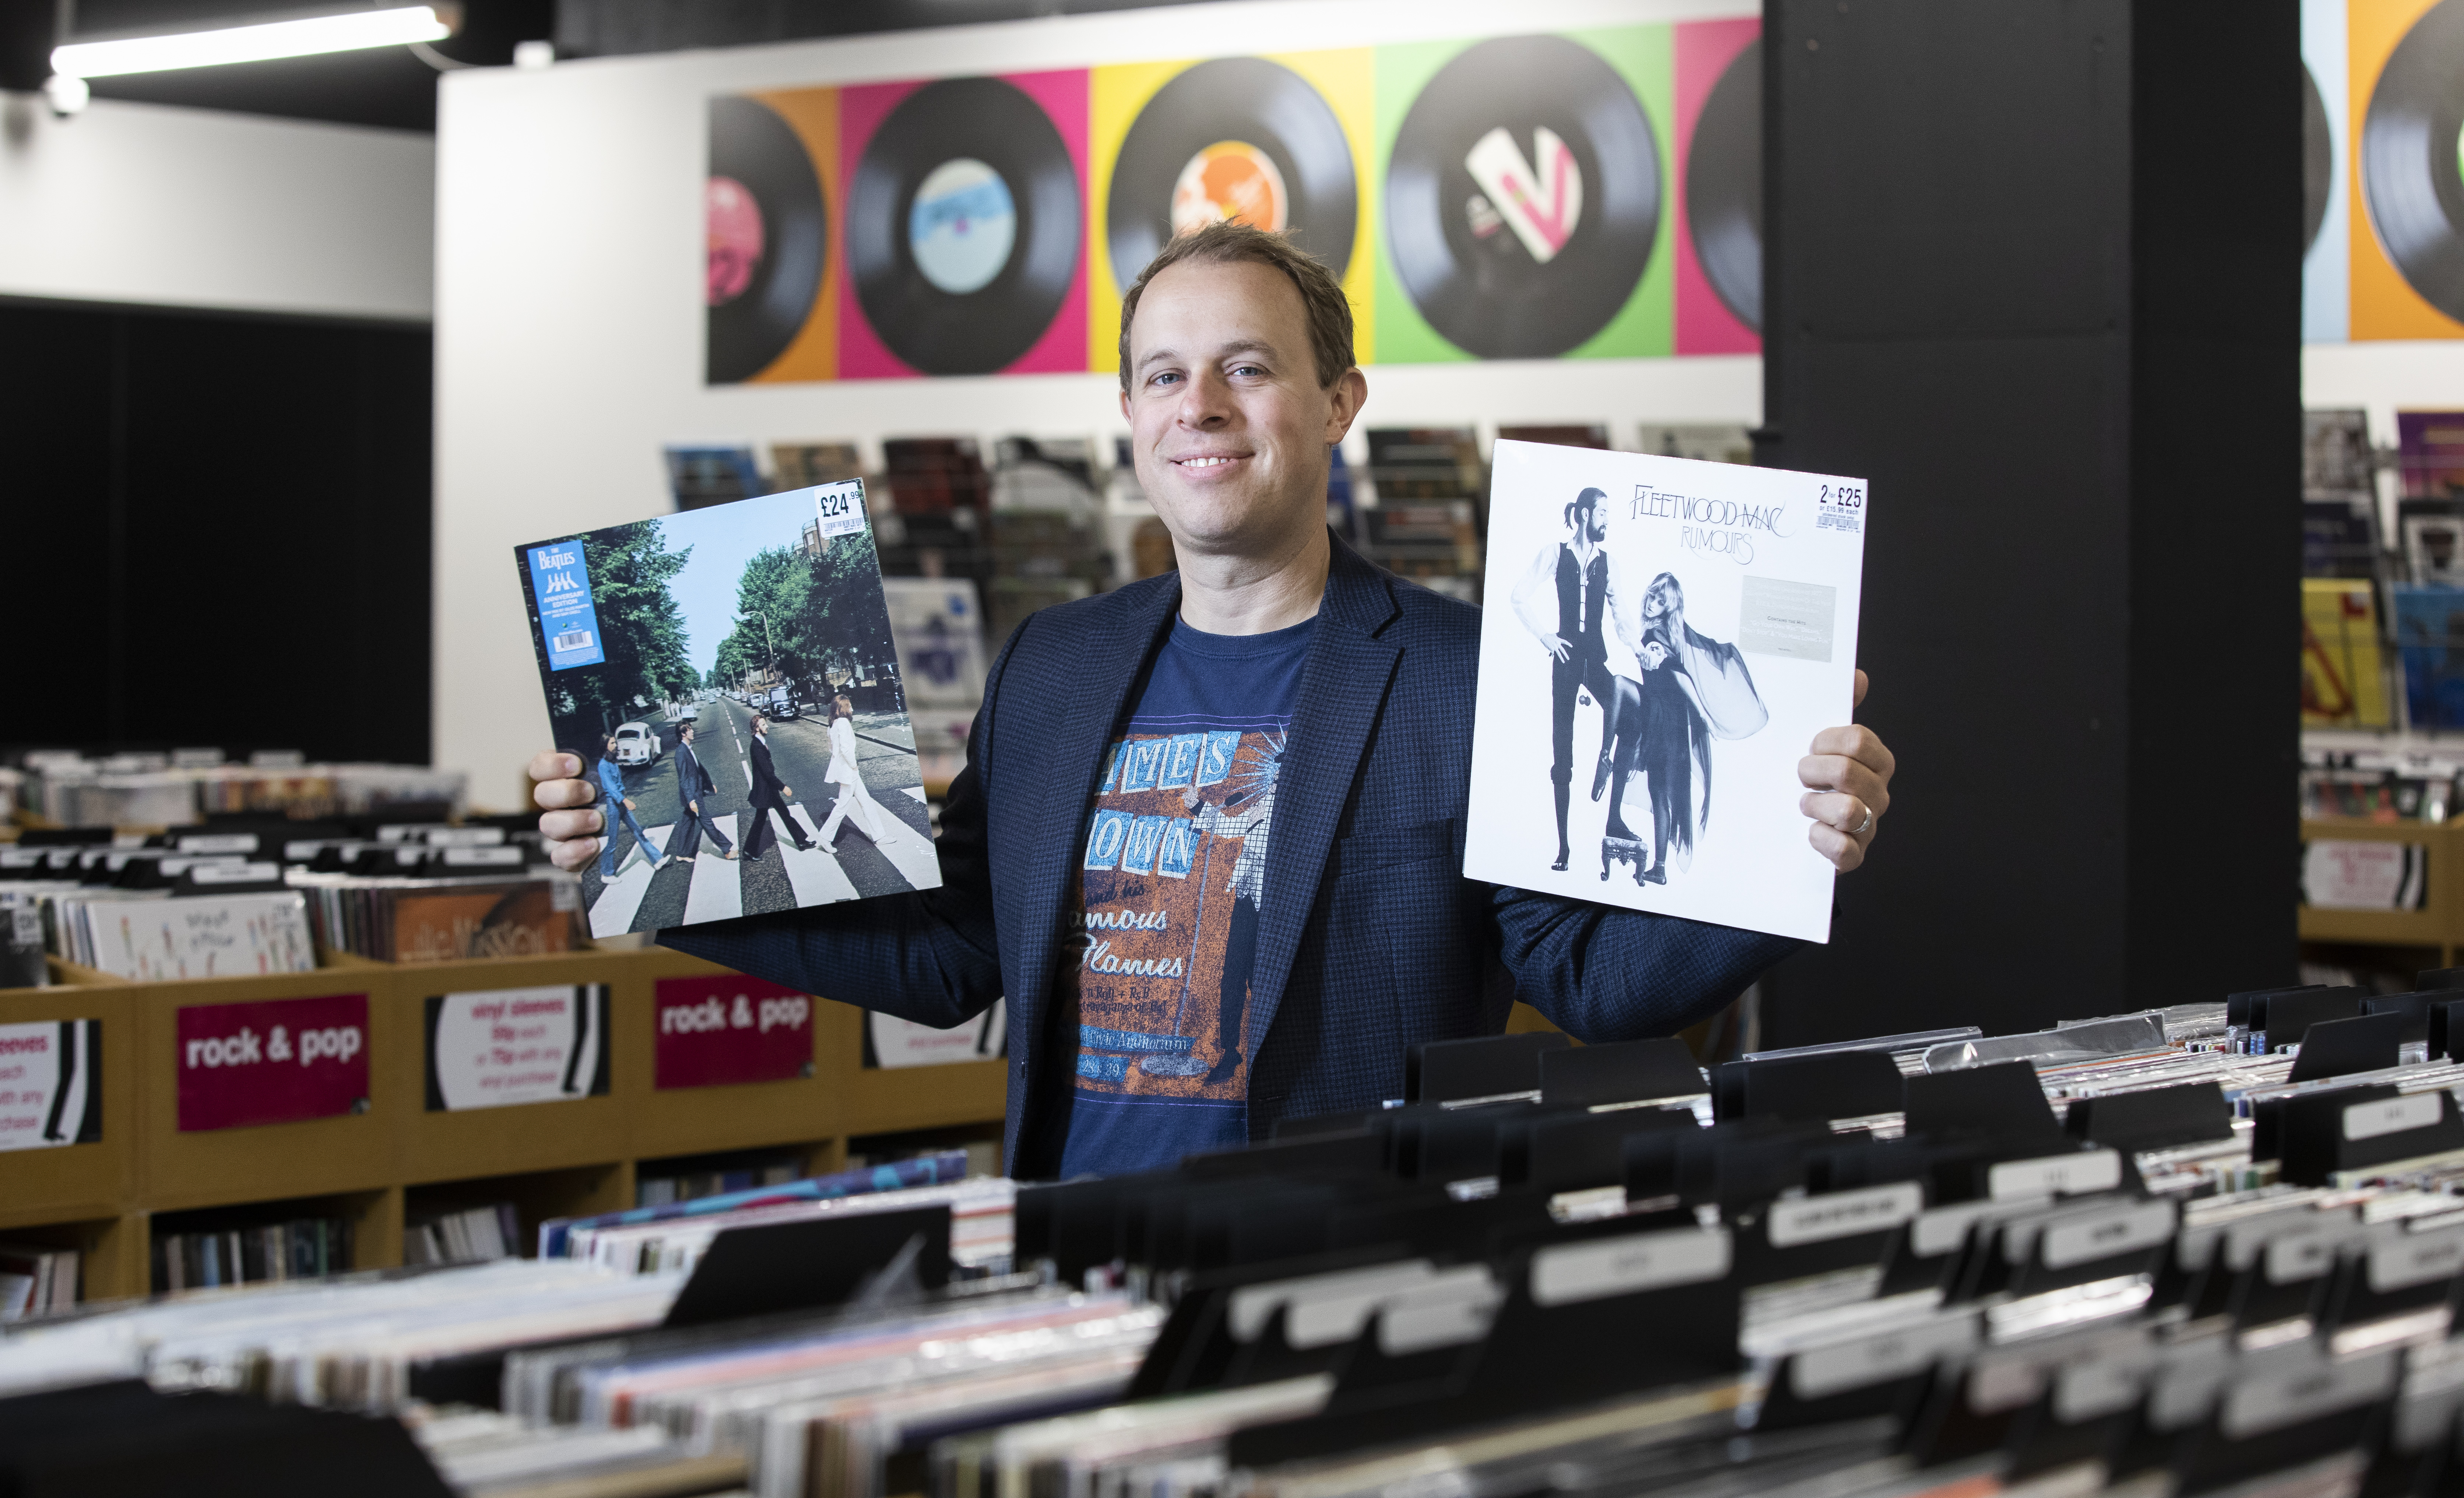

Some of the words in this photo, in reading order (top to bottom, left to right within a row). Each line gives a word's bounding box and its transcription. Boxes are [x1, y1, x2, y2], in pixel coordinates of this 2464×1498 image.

[1820, 485, 1828, 503] 2
[1838, 487, 1861, 508] £25
[1630, 484, 1737, 525] FLEETWOOD
[1741, 500, 1795, 538] MAC
[1681, 526, 1754, 565] RUMOURS
[537, 550, 576, 570] BEATLES
[543, 590, 585, 603] ANNIVERSARY
[552, 598, 578, 608] EDITION
[662, 996, 727, 1034] rock
[730, 993, 755, 1030] &
[759, 995, 810, 1034] pop
[185, 1025, 263, 1069] rock
[266, 1024, 293, 1063] &
[299, 1025, 363, 1068] pop
[1118, 1033, 1187, 1050] Auditorium
